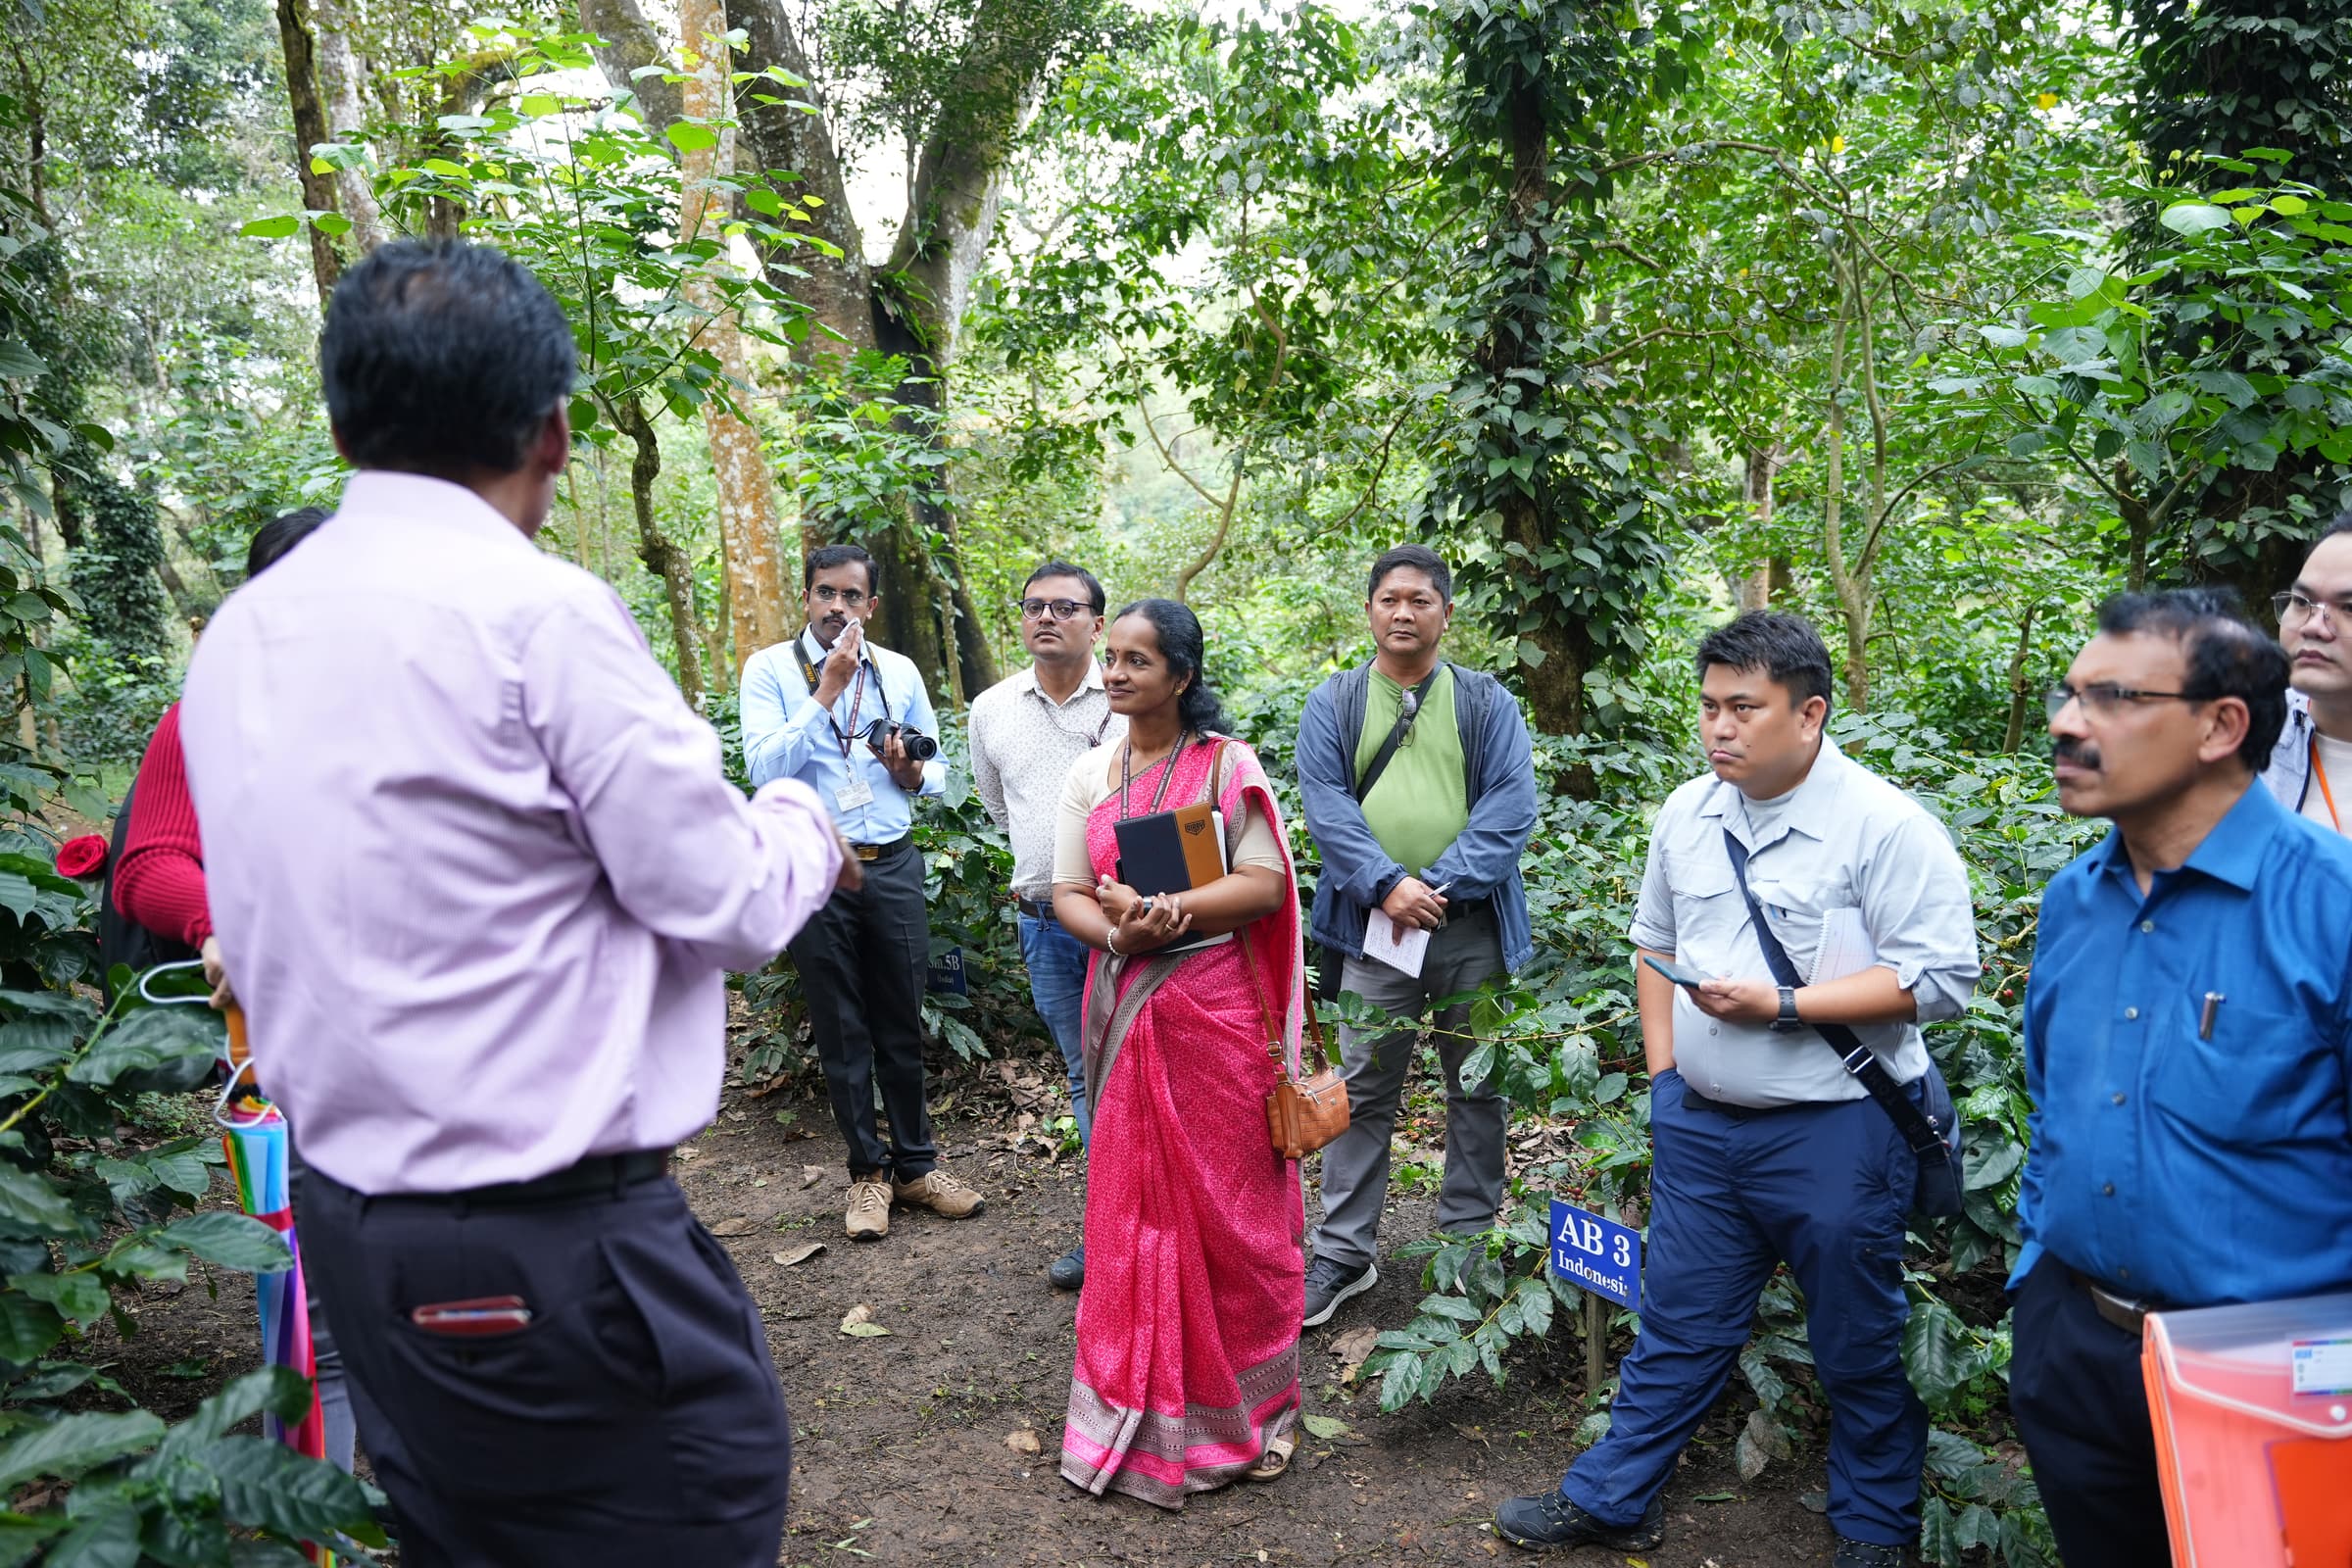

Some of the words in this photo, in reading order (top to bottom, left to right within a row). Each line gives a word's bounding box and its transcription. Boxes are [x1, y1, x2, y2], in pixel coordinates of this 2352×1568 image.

[1557, 1213, 1604, 1256] AB
[1613, 1234, 1631, 1267] 3
[1557, 1249, 1629, 1298] Indonesi
